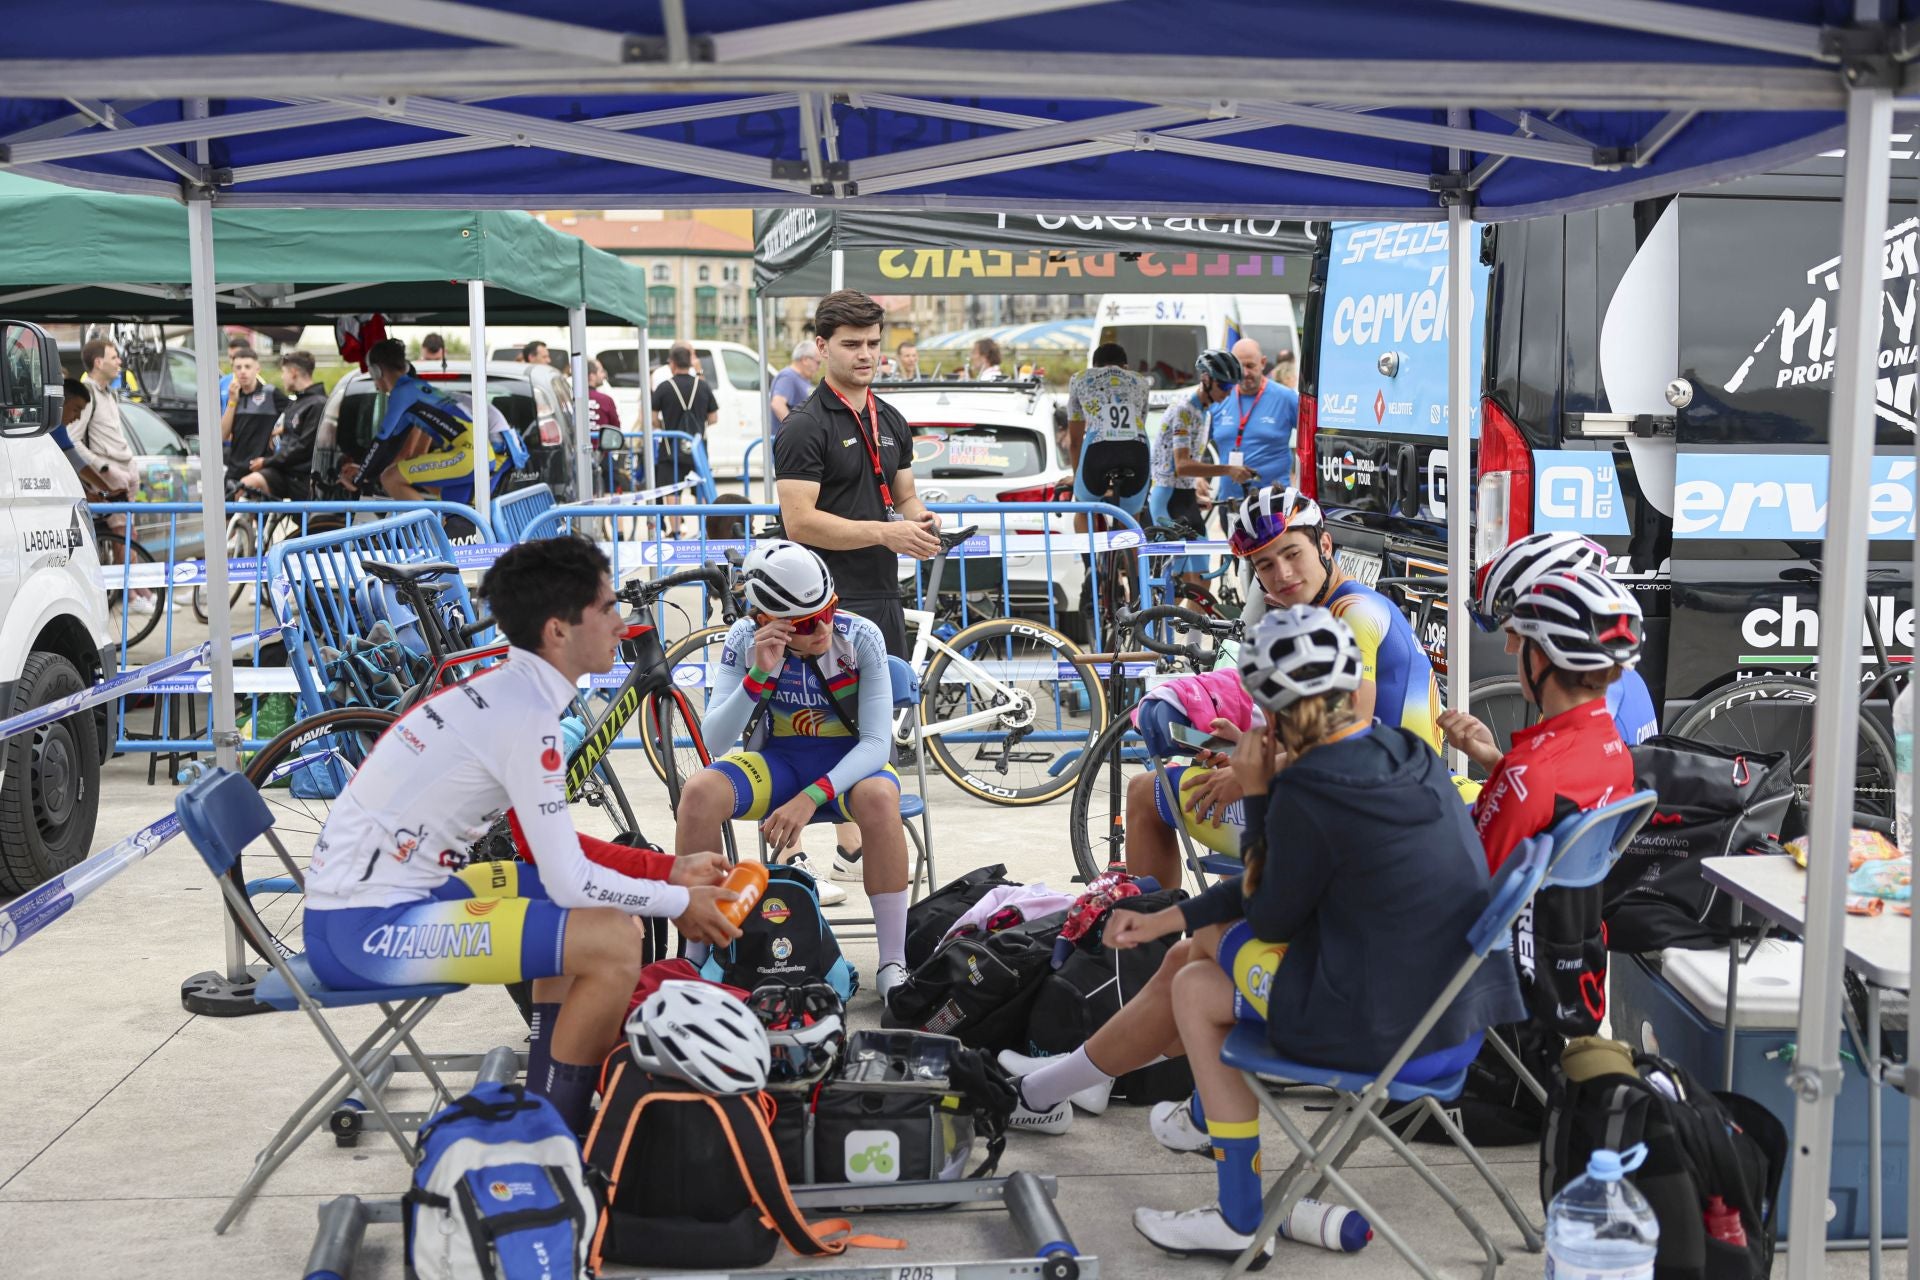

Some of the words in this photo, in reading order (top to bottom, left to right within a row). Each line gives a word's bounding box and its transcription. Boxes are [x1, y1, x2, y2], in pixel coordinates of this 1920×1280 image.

[1342, 222, 1449, 265] SPEEDS
[1109, 405, 1131, 429] 92
[1321, 394, 1358, 415] XLC
[1322, 456, 1343, 482] UCI
[1356, 458, 1375, 473] WORLD
[1357, 473, 1372, 486] TOUR
[1672, 461, 1915, 534] ervé
[23, 529, 67, 553] LABORAL
[1741, 595, 1915, 648] chlle
[1010, 624, 1066, 649] roval
[290, 723, 334, 753] MAVIC
[362, 922, 493, 960] CATALUNYA
